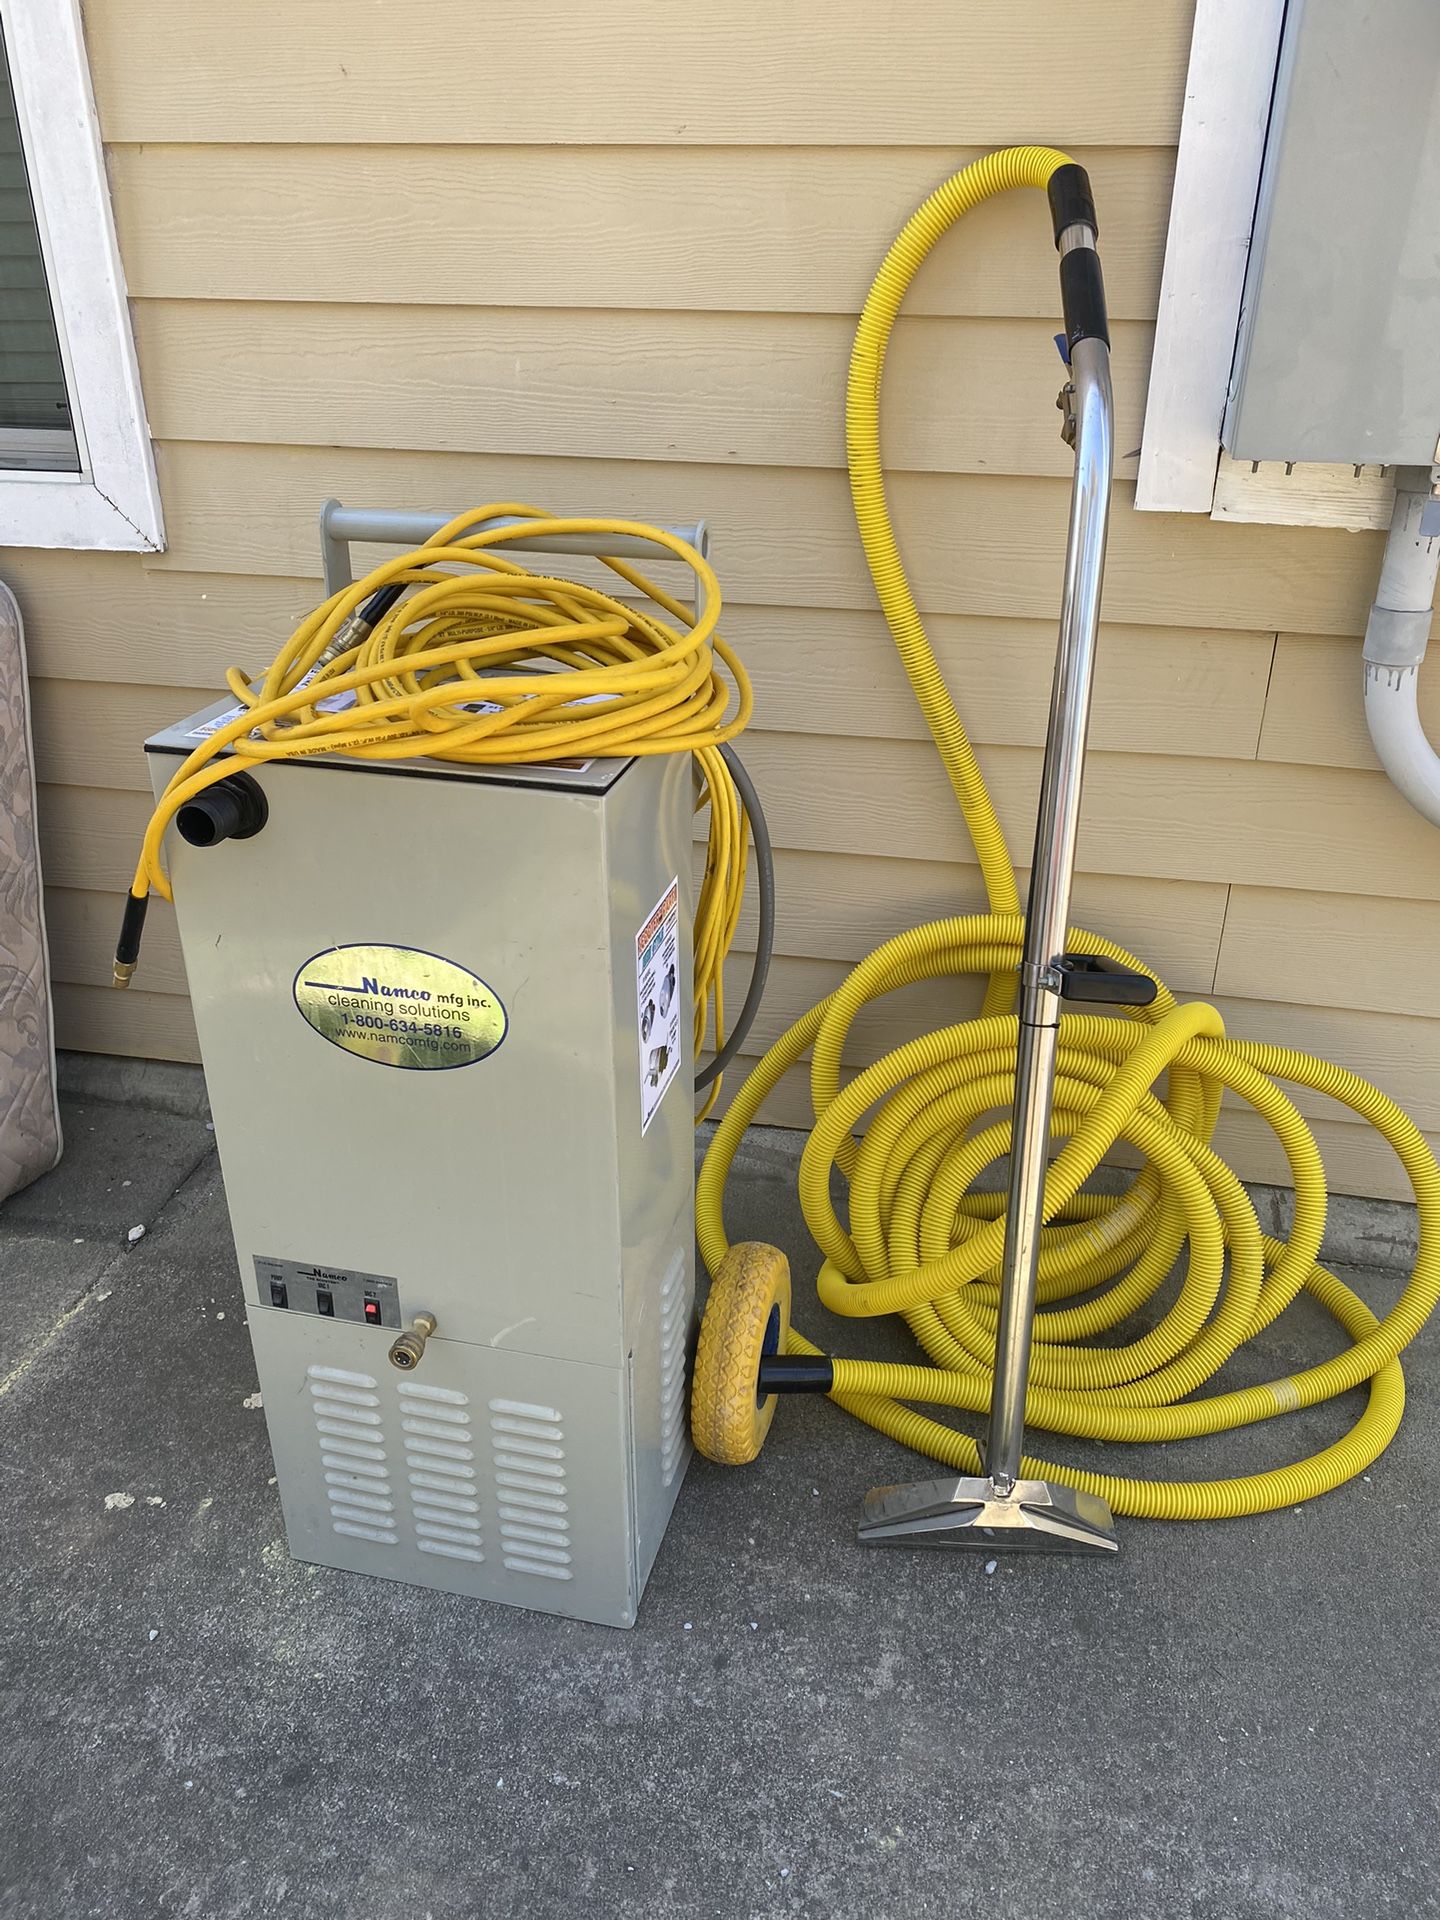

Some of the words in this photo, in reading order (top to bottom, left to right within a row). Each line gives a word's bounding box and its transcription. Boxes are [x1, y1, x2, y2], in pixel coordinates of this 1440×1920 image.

[286, 750, 300, 758] USA
[308, 746, 327, 755] MADE
[361, 976, 432, 1001] Namco
[436, 993, 463, 1007] mfg
[467, 994, 491, 1009] inc.
[328, 993, 394, 1016] cleaning
[399, 1002, 471, 1022] solutions
[341, 1013, 462, 1039] 1-800-634-5816
[335, 1027, 472, 1053] www.namcomfg.com
[313, 1268, 348, 1282] Namco
